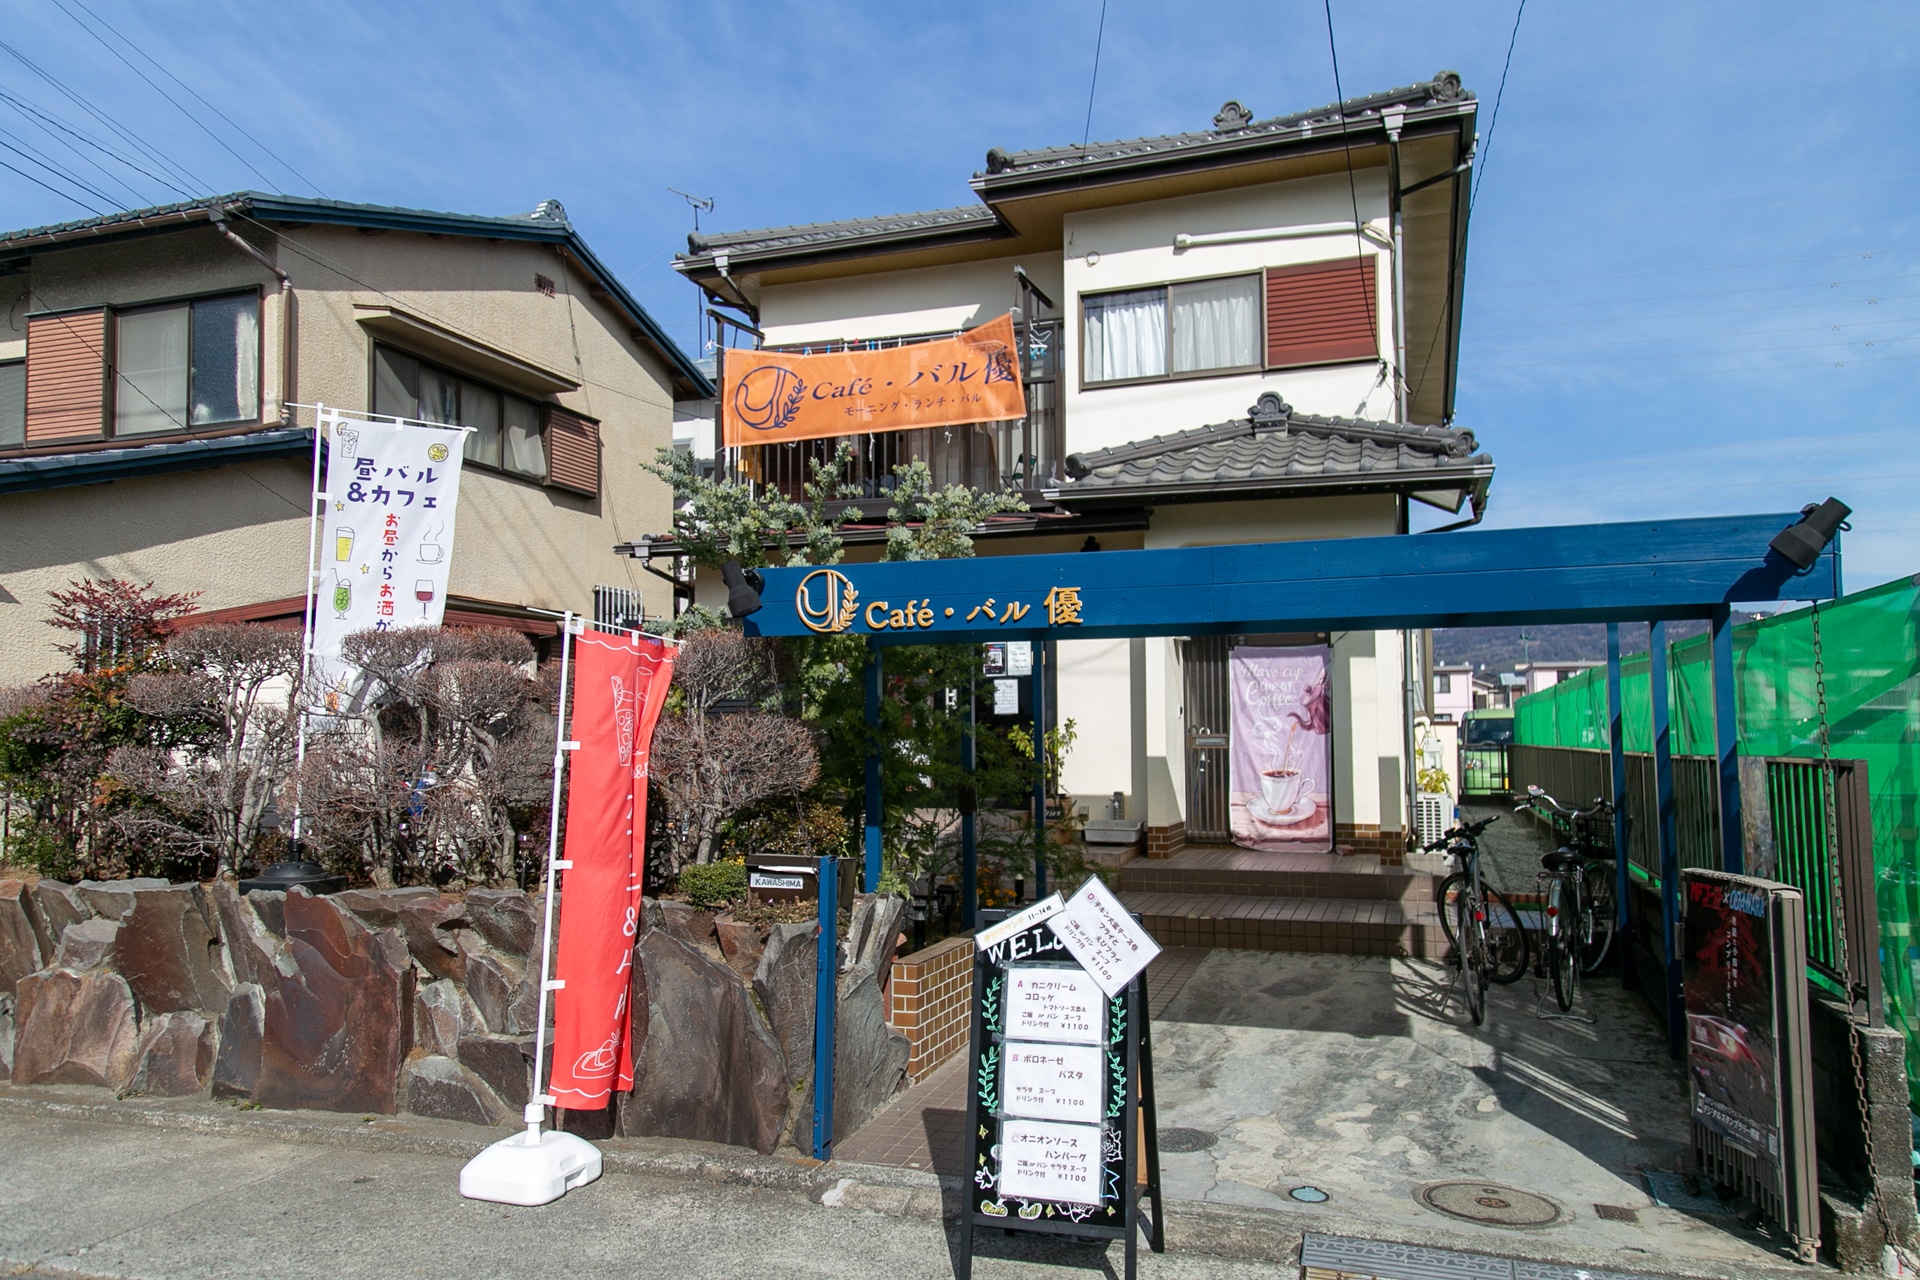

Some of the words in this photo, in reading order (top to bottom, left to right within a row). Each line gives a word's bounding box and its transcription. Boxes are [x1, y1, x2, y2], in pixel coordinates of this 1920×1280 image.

[353, 457, 439, 483] 昼バル
[755, 878, 801, 888] KAWASHIMA
[1017, 980, 1023, 988] A
[1031, 982, 1076, 991] カニクリーム
[1025, 993, 1054, 1001] コロッケ
[1012, 1054, 1019, 1062] B
[1021, 1134, 1077, 1147] オニオンソース
[1045, 1150, 1087, 1162] ハンバーグ
